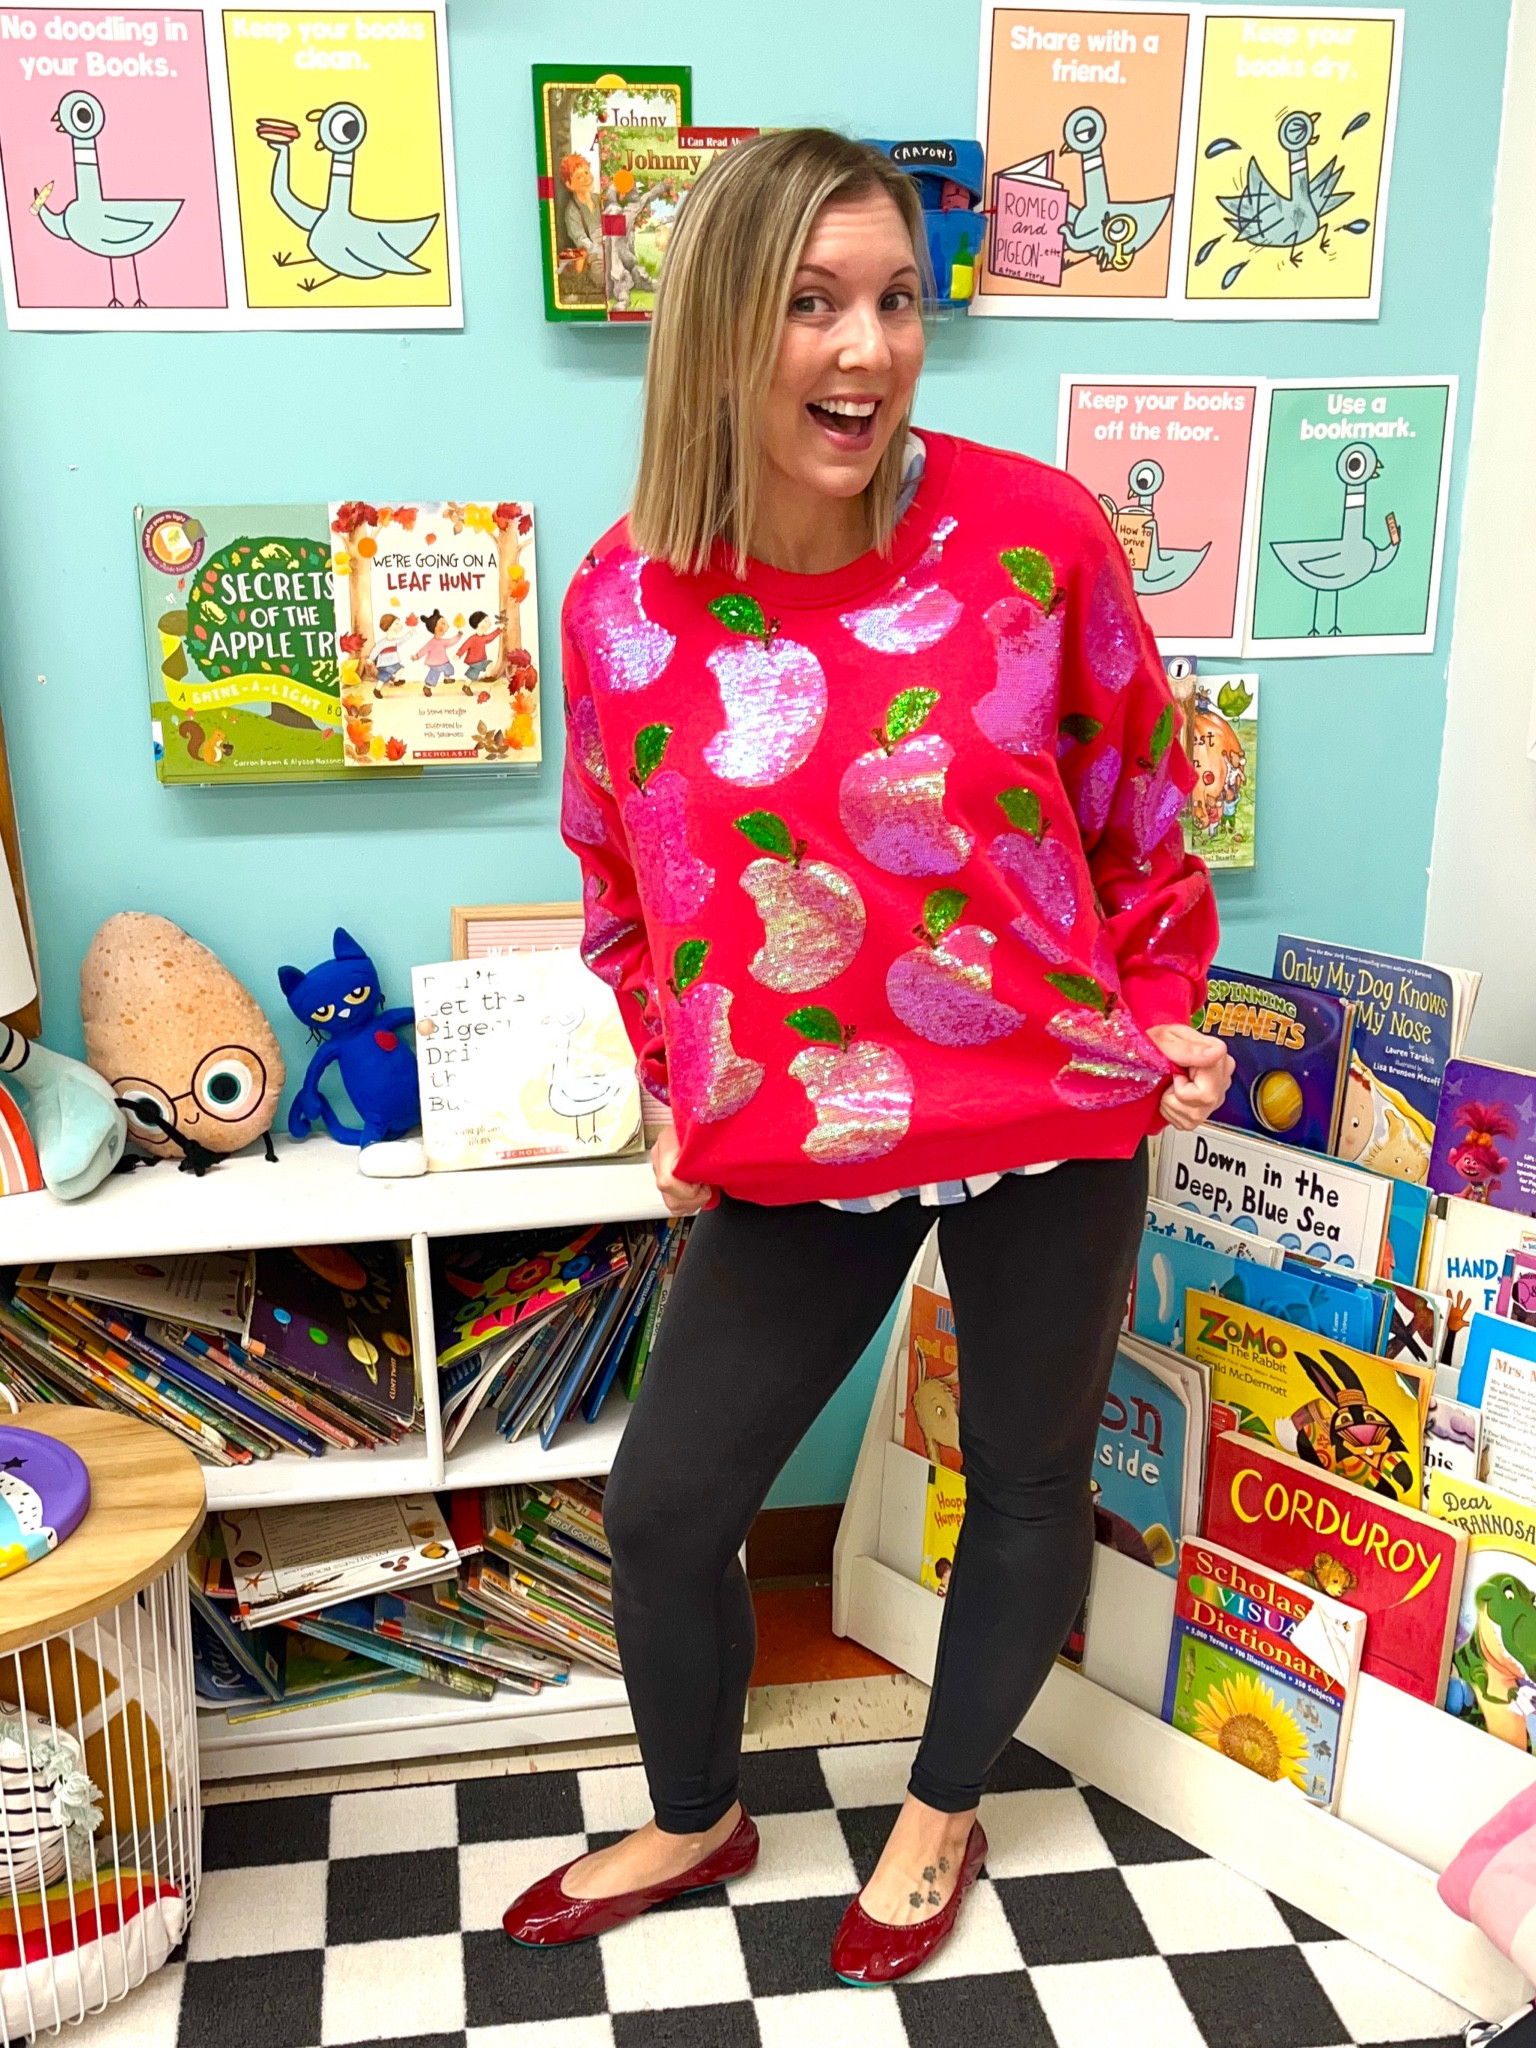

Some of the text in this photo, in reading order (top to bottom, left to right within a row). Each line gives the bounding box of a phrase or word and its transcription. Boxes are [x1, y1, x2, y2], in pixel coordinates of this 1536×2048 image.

[1, 16, 188, 47] No doodling in
[232, 16, 425, 44] Keep your books
[1011, 25, 1159, 54] Share with a
[1242, 21, 1357, 50] Keep your
[20, 52, 178, 81] your Books.
[294, 47, 371, 71] clean.
[1052, 58, 1127, 84] friend.
[1236, 54, 1357, 80] books dry.
[611, 108, 667, 127] Johnny
[687, 137, 704, 147] Can
[706, 137, 728, 147] Read
[894, 146, 954, 162] CRAYONS
[622, 149, 703, 176] Johnny
[1004, 193, 1060, 220] ROMEO
[1012, 221, 1048, 236] and
[1078, 390, 1246, 414] Keep your books
[1327, 394, 1387, 415] Use a
[1094, 421, 1220, 442] off the floor.
[1300, 417, 1416, 441] bookmark.
[1120, 525, 1152, 537] How to
[1123, 538, 1145, 548] Drive
[463, 554, 483, 568] ON
[488, 553, 497, 568] A
[1128, 548, 1135, 556] A
[220, 571, 334, 605] SECRETS
[387, 571, 486, 592] LEAF HUNT
[250, 605, 320, 629] OF THE
[208, 631, 296, 660] APPLE
[179, 692, 186, 703] A
[421, 750, 478, 759] SCHOLASTIC
[1282, 950, 1448, 1018] Only My Dog Knows
[1208, 979, 1297, 1018] SPINNING
[1203, 1003, 1306, 1050] PLANETS
[1356, 1000, 1432, 1045] My Nose
[1373, 1062, 1387, 1072] Lisa
[1385, 1046, 1435, 1065] Lauren Tarshis
[1194, 1136, 1340, 1208] Down in the
[1175, 1163, 1341, 1242] Deep, Blue Sea
[1447, 1257, 1502, 1284] HAND,
[1229, 1343, 1288, 1375] The Rabbit
[1495, 1357, 1524, 1379] Mrs.
[1229, 1367, 1288, 1398] McDermott
[1099, 1443, 1160, 1485] side
[1443, 1492, 1492, 1512] Dear
[570, 1526, 590, 1542] God
[1231, 1469, 1442, 1609] CORDUROY
[1196, 1551, 1308, 1620] Scholas
[1217, 1587, 1300, 1638] VISUA
[1190, 1601, 1337, 1692] Dictionary
[1208, 1634, 1228, 1650] Terms
[1246, 1651, 1287, 1680] Illustrations
[1307, 1684, 1335, 1705] Subjects
